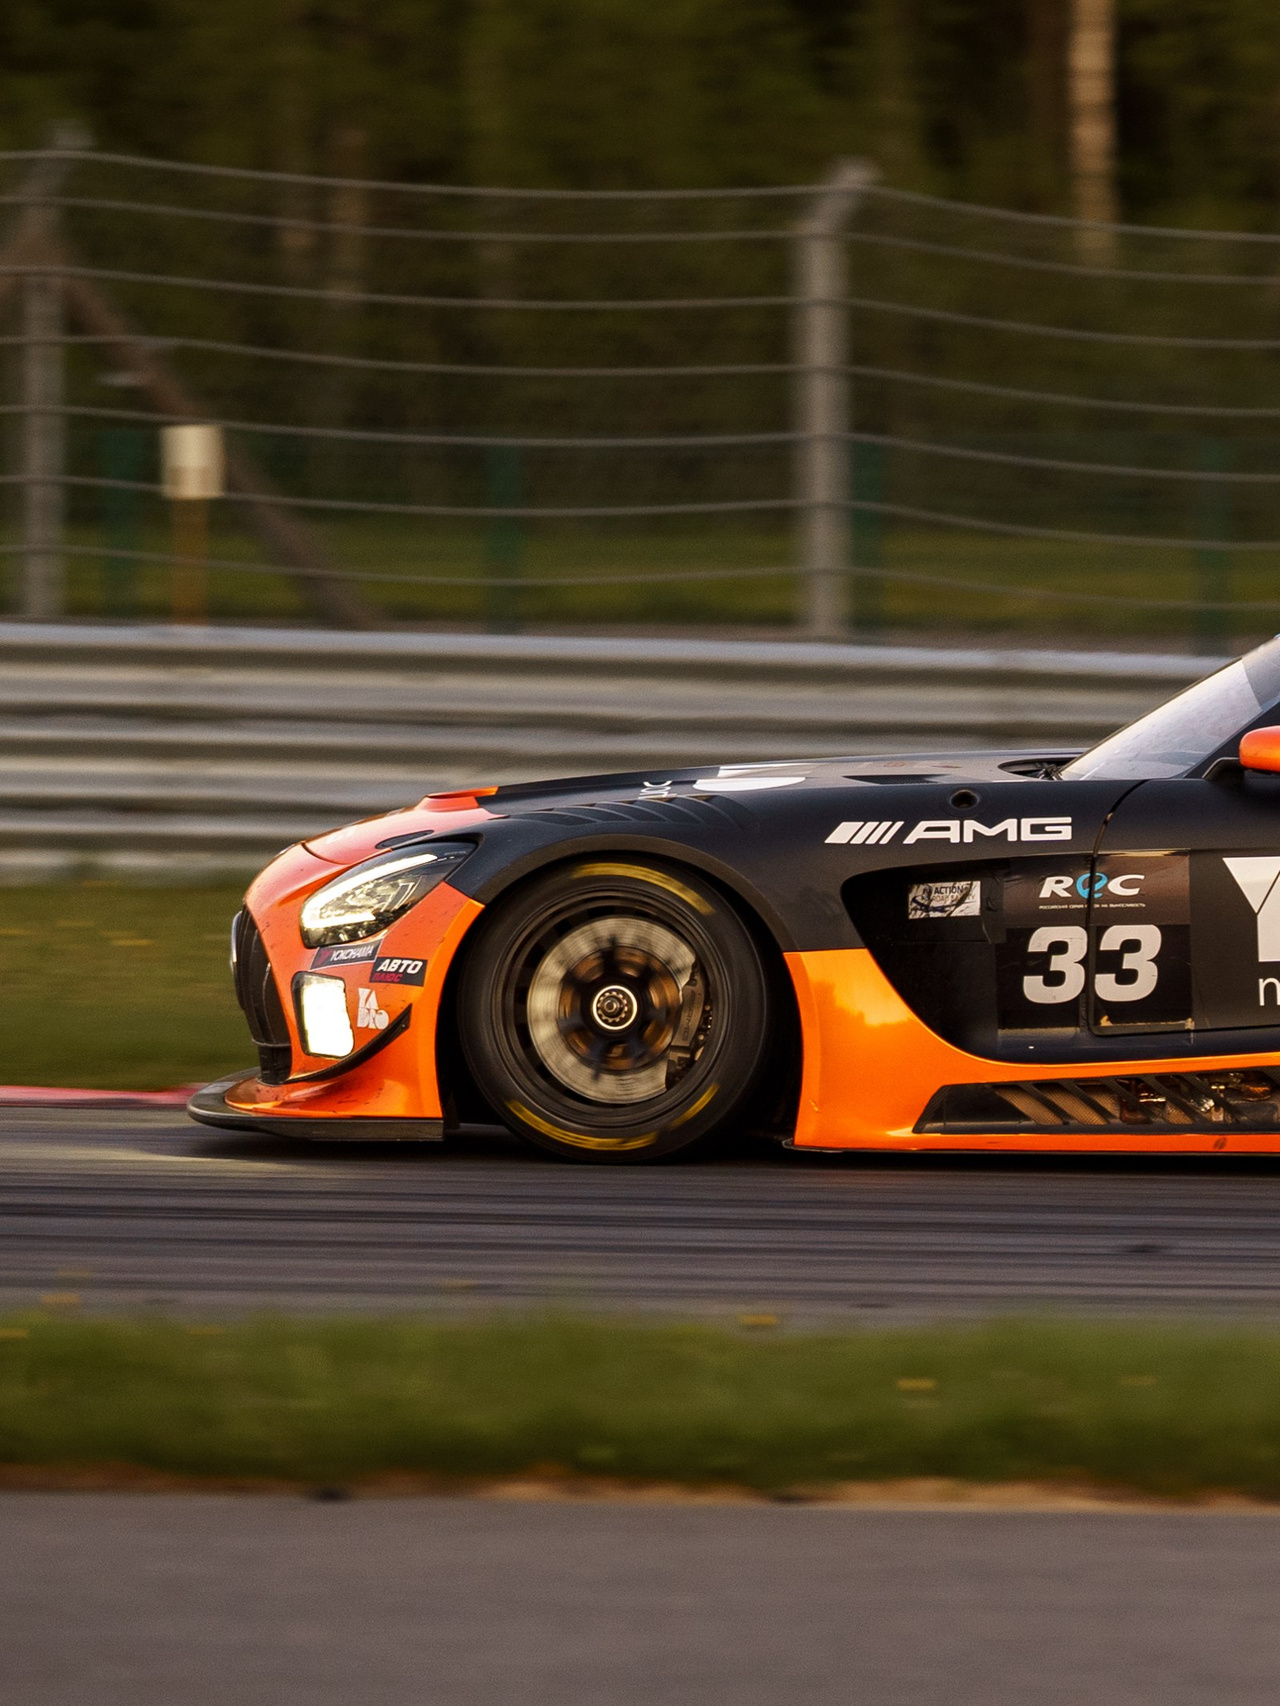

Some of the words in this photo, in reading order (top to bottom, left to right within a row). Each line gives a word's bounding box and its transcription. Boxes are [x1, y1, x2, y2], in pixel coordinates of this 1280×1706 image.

[330, 945, 375, 961] YOKOHAMA
[377, 959, 423, 974] АВТО
[1022, 924, 1162, 1005] 33
